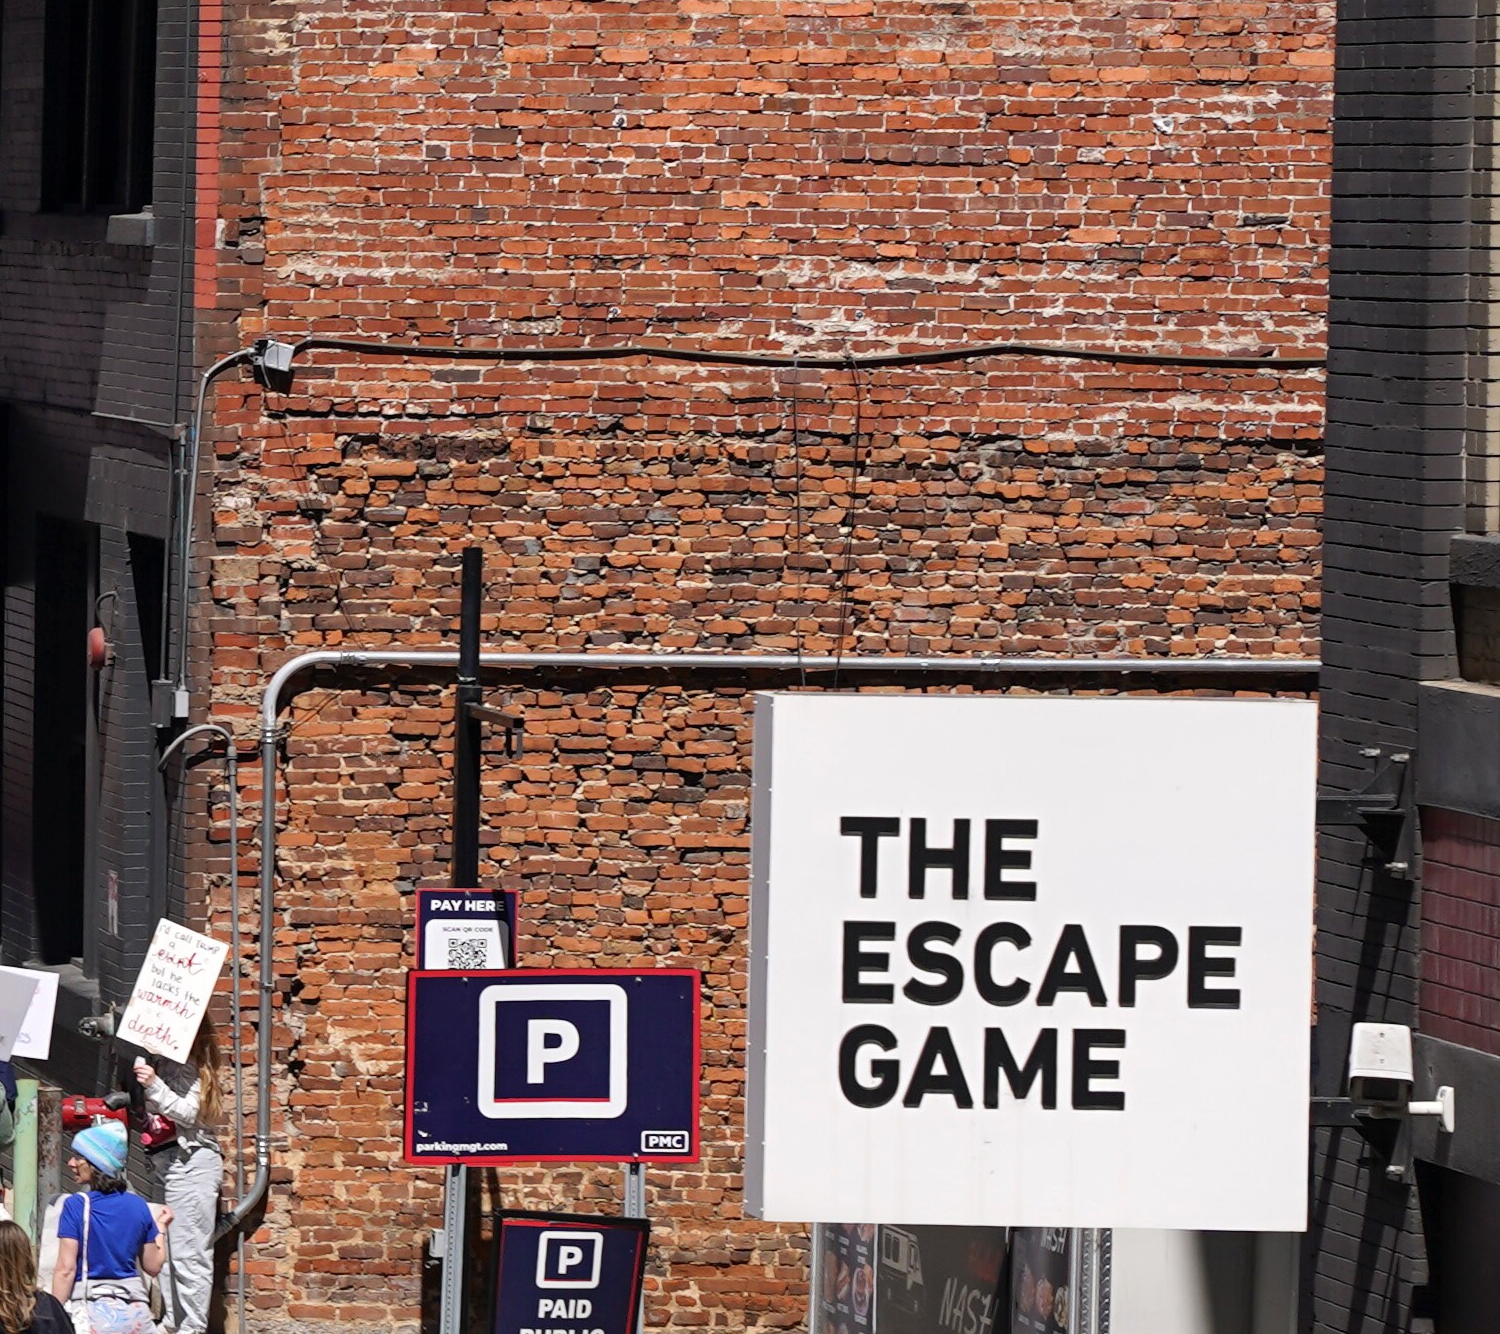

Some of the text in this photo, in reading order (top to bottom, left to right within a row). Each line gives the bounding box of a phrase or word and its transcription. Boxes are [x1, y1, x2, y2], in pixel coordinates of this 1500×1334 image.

[840, 816, 1039, 901] THE
[430, 899, 505, 913] PAY HERE
[841, 921, 1243, 1011] ESCAPE
[525, 1018, 581, 1085] P
[839, 1023, 1126, 1112] GAME
[416, 1140, 508, 1154] parkingmgt.com
[646, 1133, 685, 1150] PMC
[556, 1244, 584, 1276] P
[537, 1298, 594, 1320] PAID
